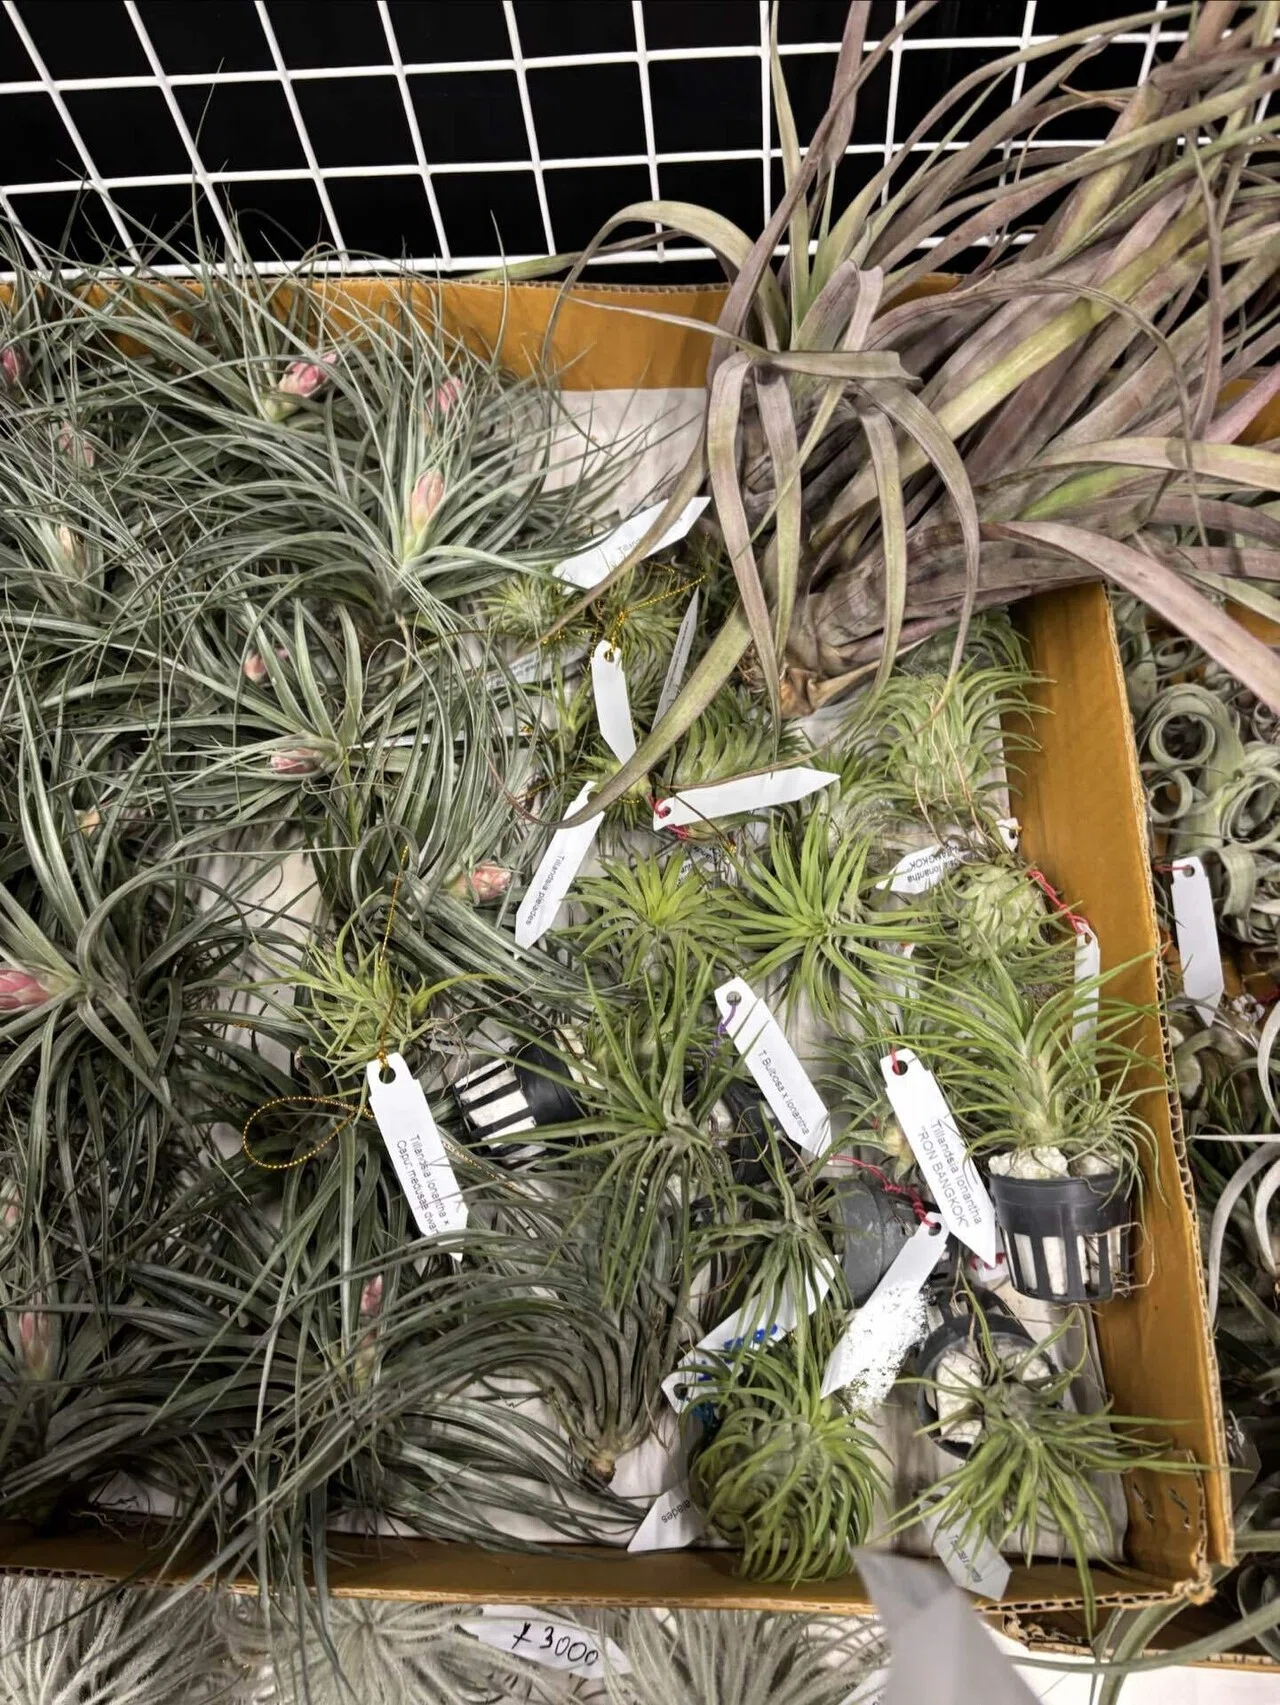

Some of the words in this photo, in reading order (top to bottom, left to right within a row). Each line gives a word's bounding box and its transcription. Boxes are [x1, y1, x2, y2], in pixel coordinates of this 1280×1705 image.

[543, 855, 566, 891] Tillandsia
[410, 1134, 432, 1178] Tillandsia
[930, 1118, 959, 1173] Tillandsia
[955, 1173, 983, 1225] Ionantha
[424, 1211, 439, 1234] dwar
